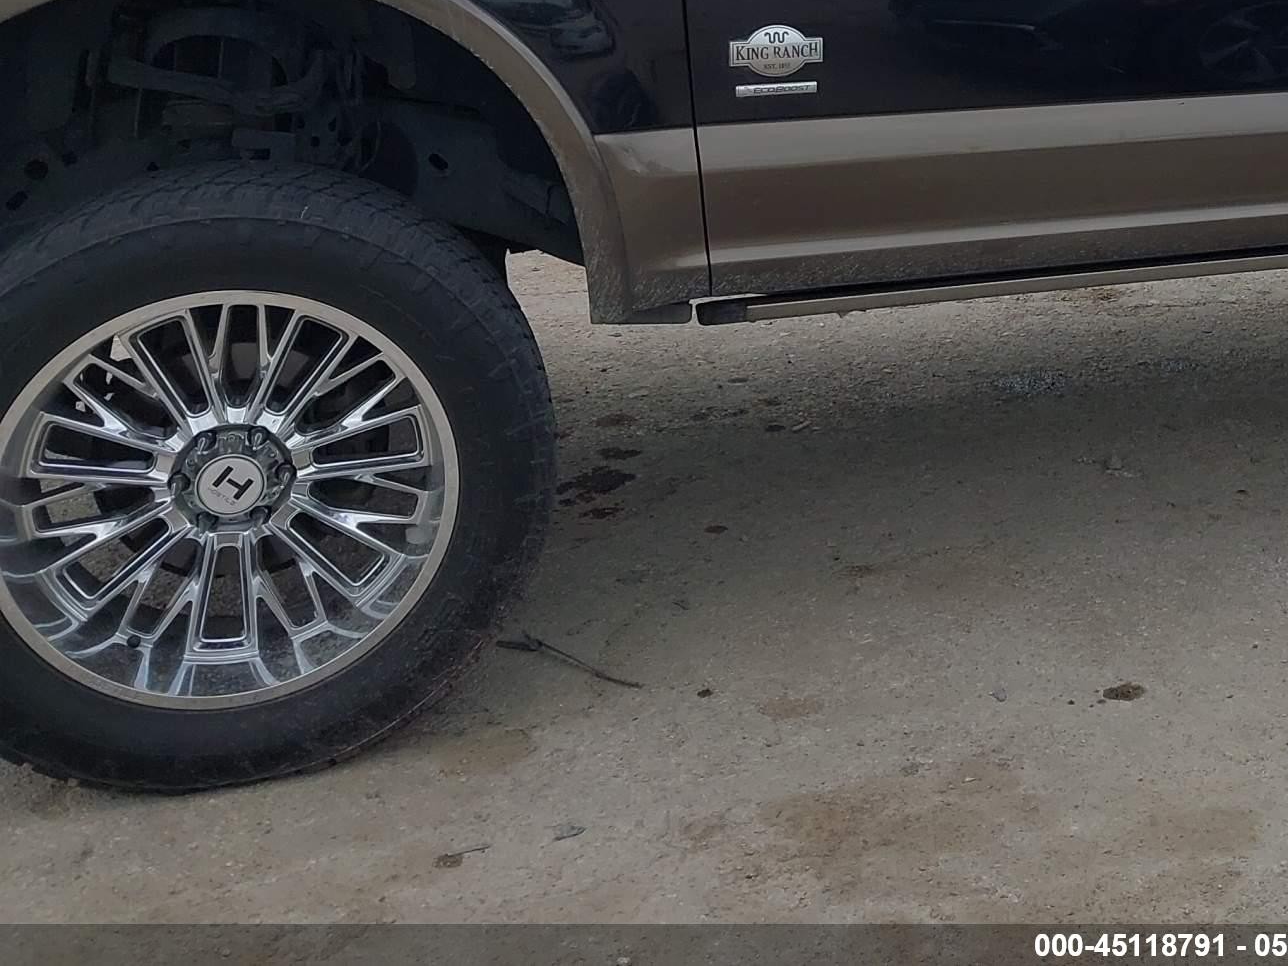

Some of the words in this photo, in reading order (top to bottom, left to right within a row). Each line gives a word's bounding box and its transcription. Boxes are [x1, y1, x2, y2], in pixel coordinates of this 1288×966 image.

[735, 45, 769, 61] KING
[773, 41, 819, 59] RANCH
[211, 465, 254, 501] H
